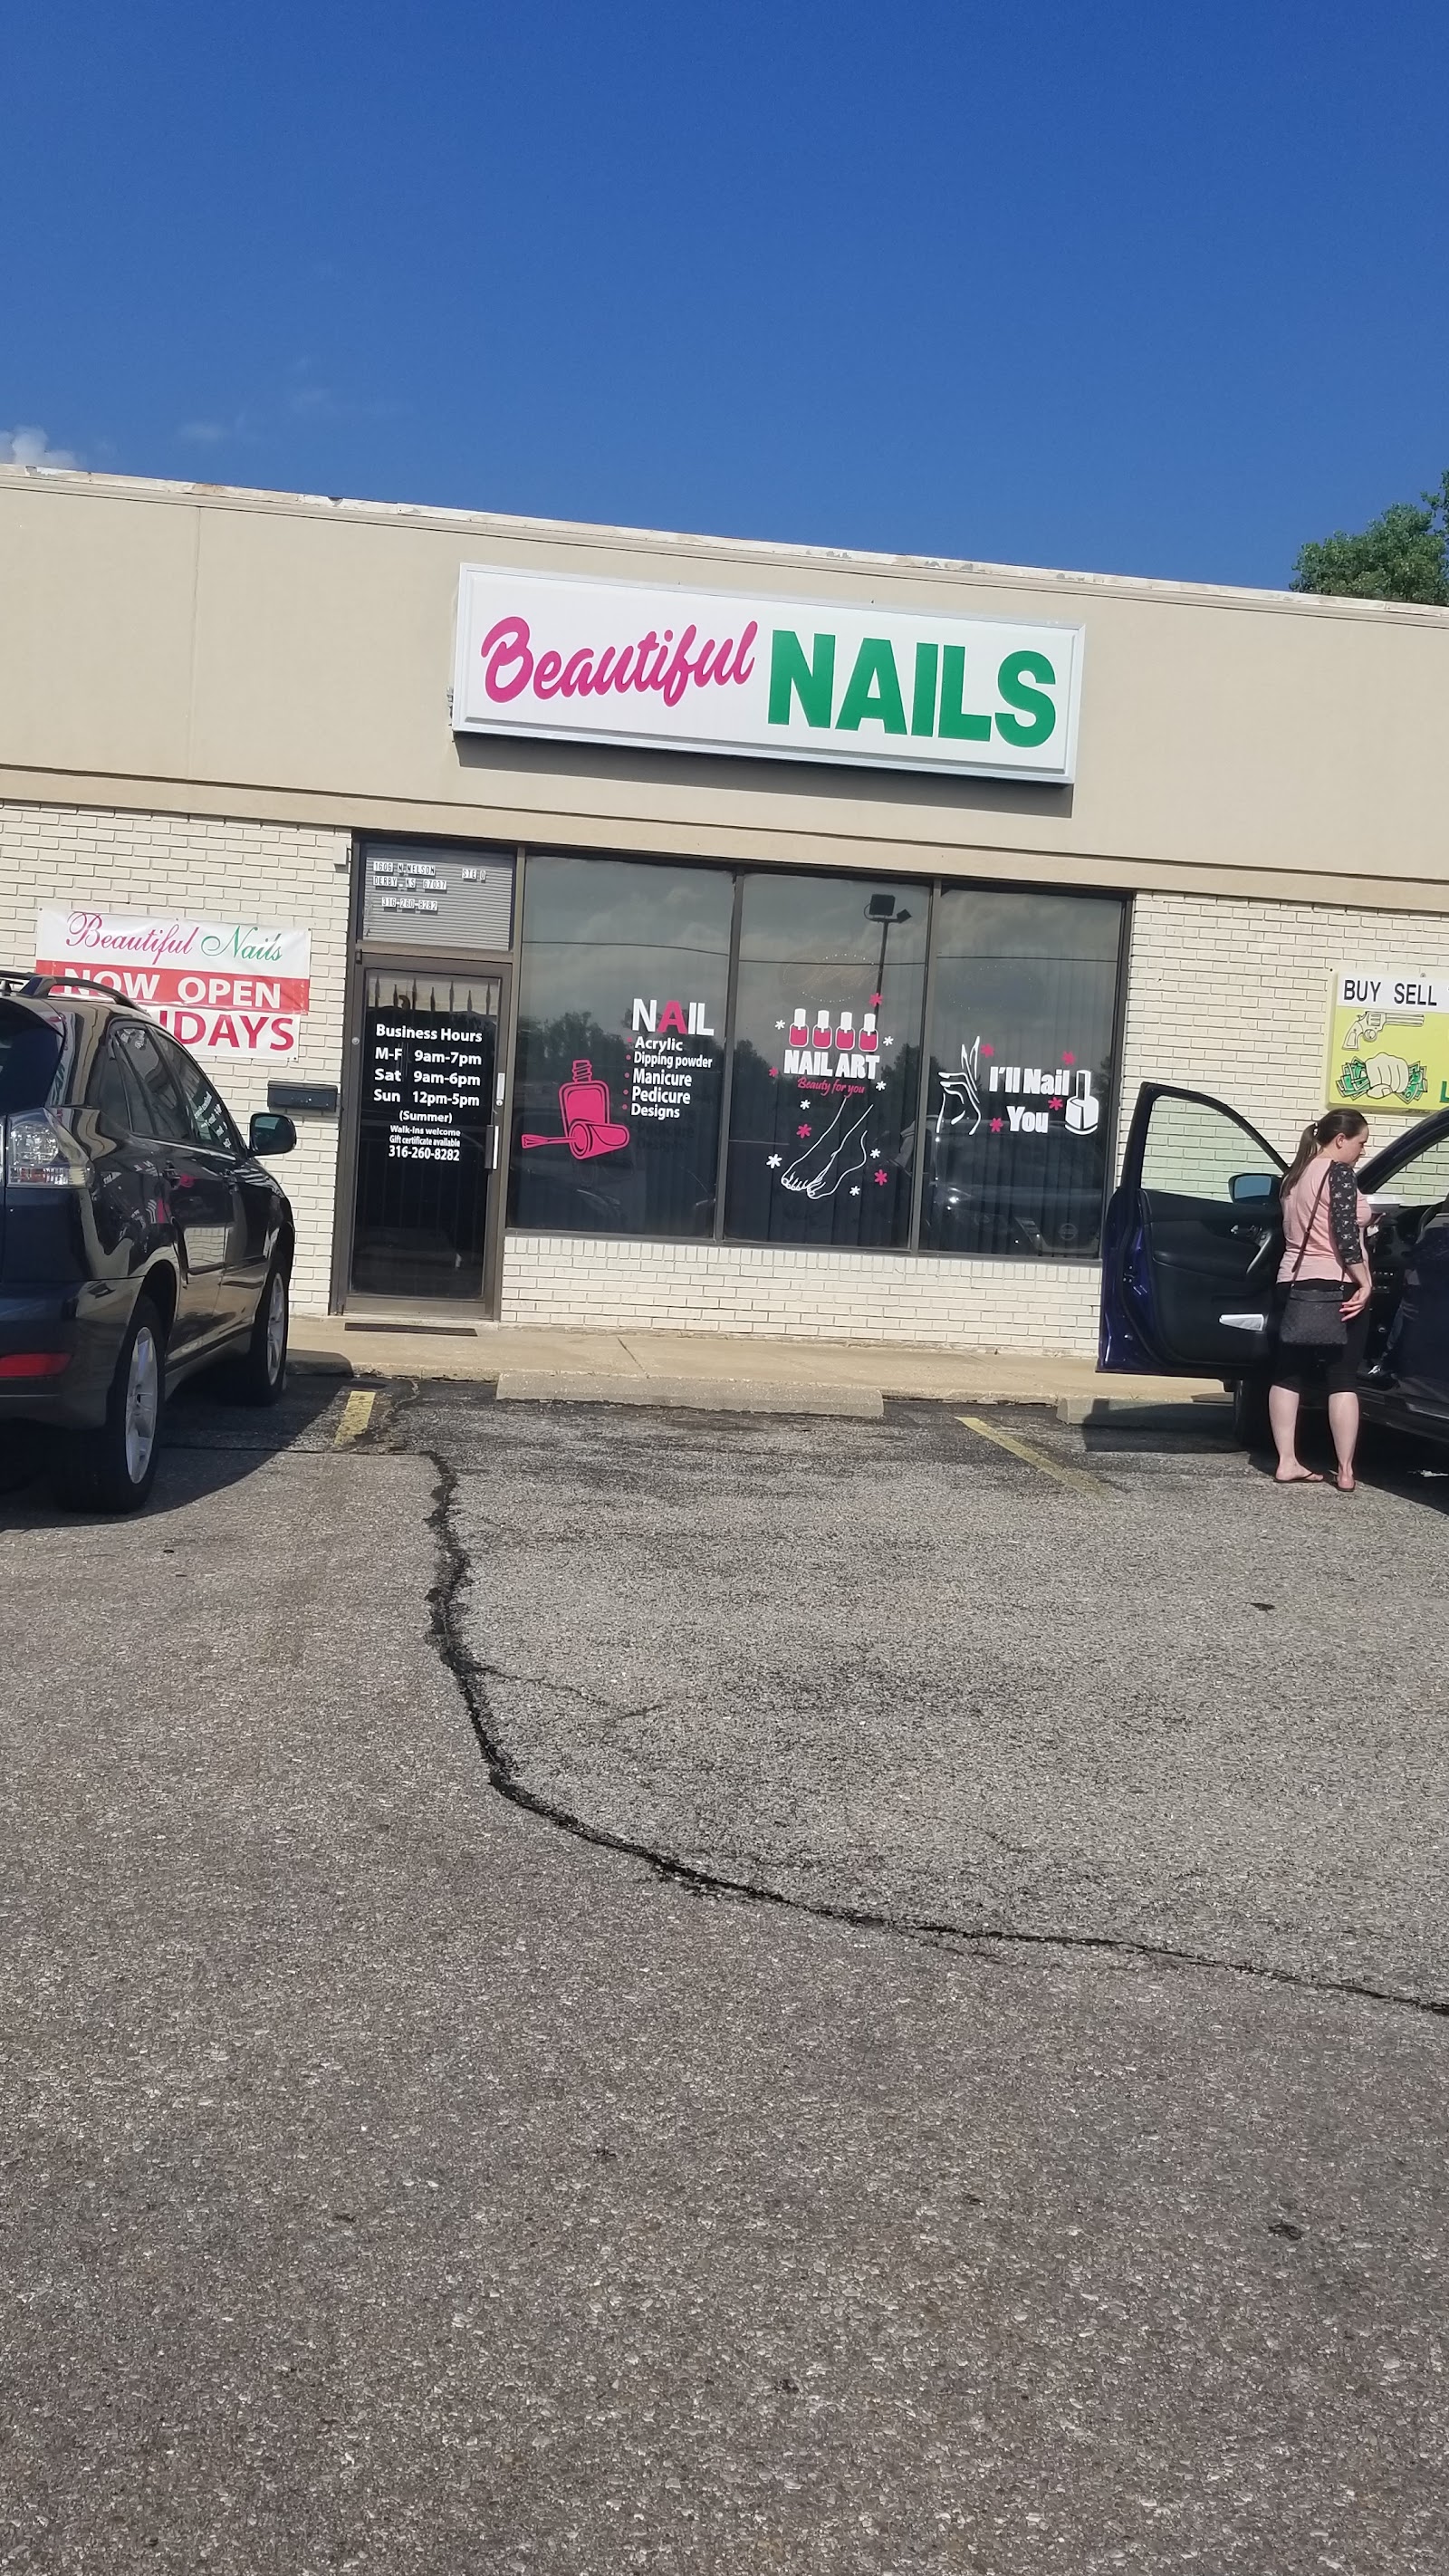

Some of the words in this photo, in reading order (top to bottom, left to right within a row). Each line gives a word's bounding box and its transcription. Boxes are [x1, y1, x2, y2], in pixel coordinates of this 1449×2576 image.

[480, 616, 758, 707] Beautiful
[768, 630, 1057, 747] NAILS
[373, 861, 393, 871] 1606
[406, 878, 416, 888] KS
[423, 879, 446, 890] 67037
[382, 897, 437, 910] 316-260-8282
[65, 911, 199, 966] Beautiful
[200, 925, 283, 962] Nails
[64, 967, 160, 1001] NOW
[178, 976, 281, 1009] OPEN
[1343, 979, 1381, 1003] BUY
[1394, 983, 1437, 1006] SELL
[631, 998, 715, 1036] NAIL
[376, 1024, 437, 1041] Business
[440, 1028, 483, 1043] Hours
[634, 1036, 683, 1053] Acrylic
[375, 1046, 403, 1061] M-F
[414, 1050, 482, 1067] 9am-7pm
[633, 1051, 673, 1069] Dipping
[675, 1054, 713, 1069] powder
[783, 1049, 833, 1077] NAIL
[835, 1053, 880, 1080] ART
[374, 1068, 402, 1082] Sat
[413, 1071, 481, 1088] 9am-6pm
[632, 1068, 692, 1087] Manicure
[989, 1066, 1021, 1093] I'll
[1022, 1068, 1070, 1096] Nail
[631, 1086, 691, 1105] Pedicure
[797, 1076, 830, 1097] Beauty
[831, 1078, 847, 1094] for
[843, 1085, 865, 1099] you
[373, 1089, 401, 1103] Sun
[412, 1091, 480, 1108] 12pm-5pm
[399, 1110, 453, 1124] (Summer)
[630, 1102, 681, 1120] Designs
[1006, 1106, 1050, 1133] You
[389, 1134, 401, 1144] Gift
[402, 1136, 432, 1146] certificate
[433, 1137, 461, 1147] available
[425, 1127, 461, 1137] welcome
[388, 1145, 460, 1162] 316-260-8282
